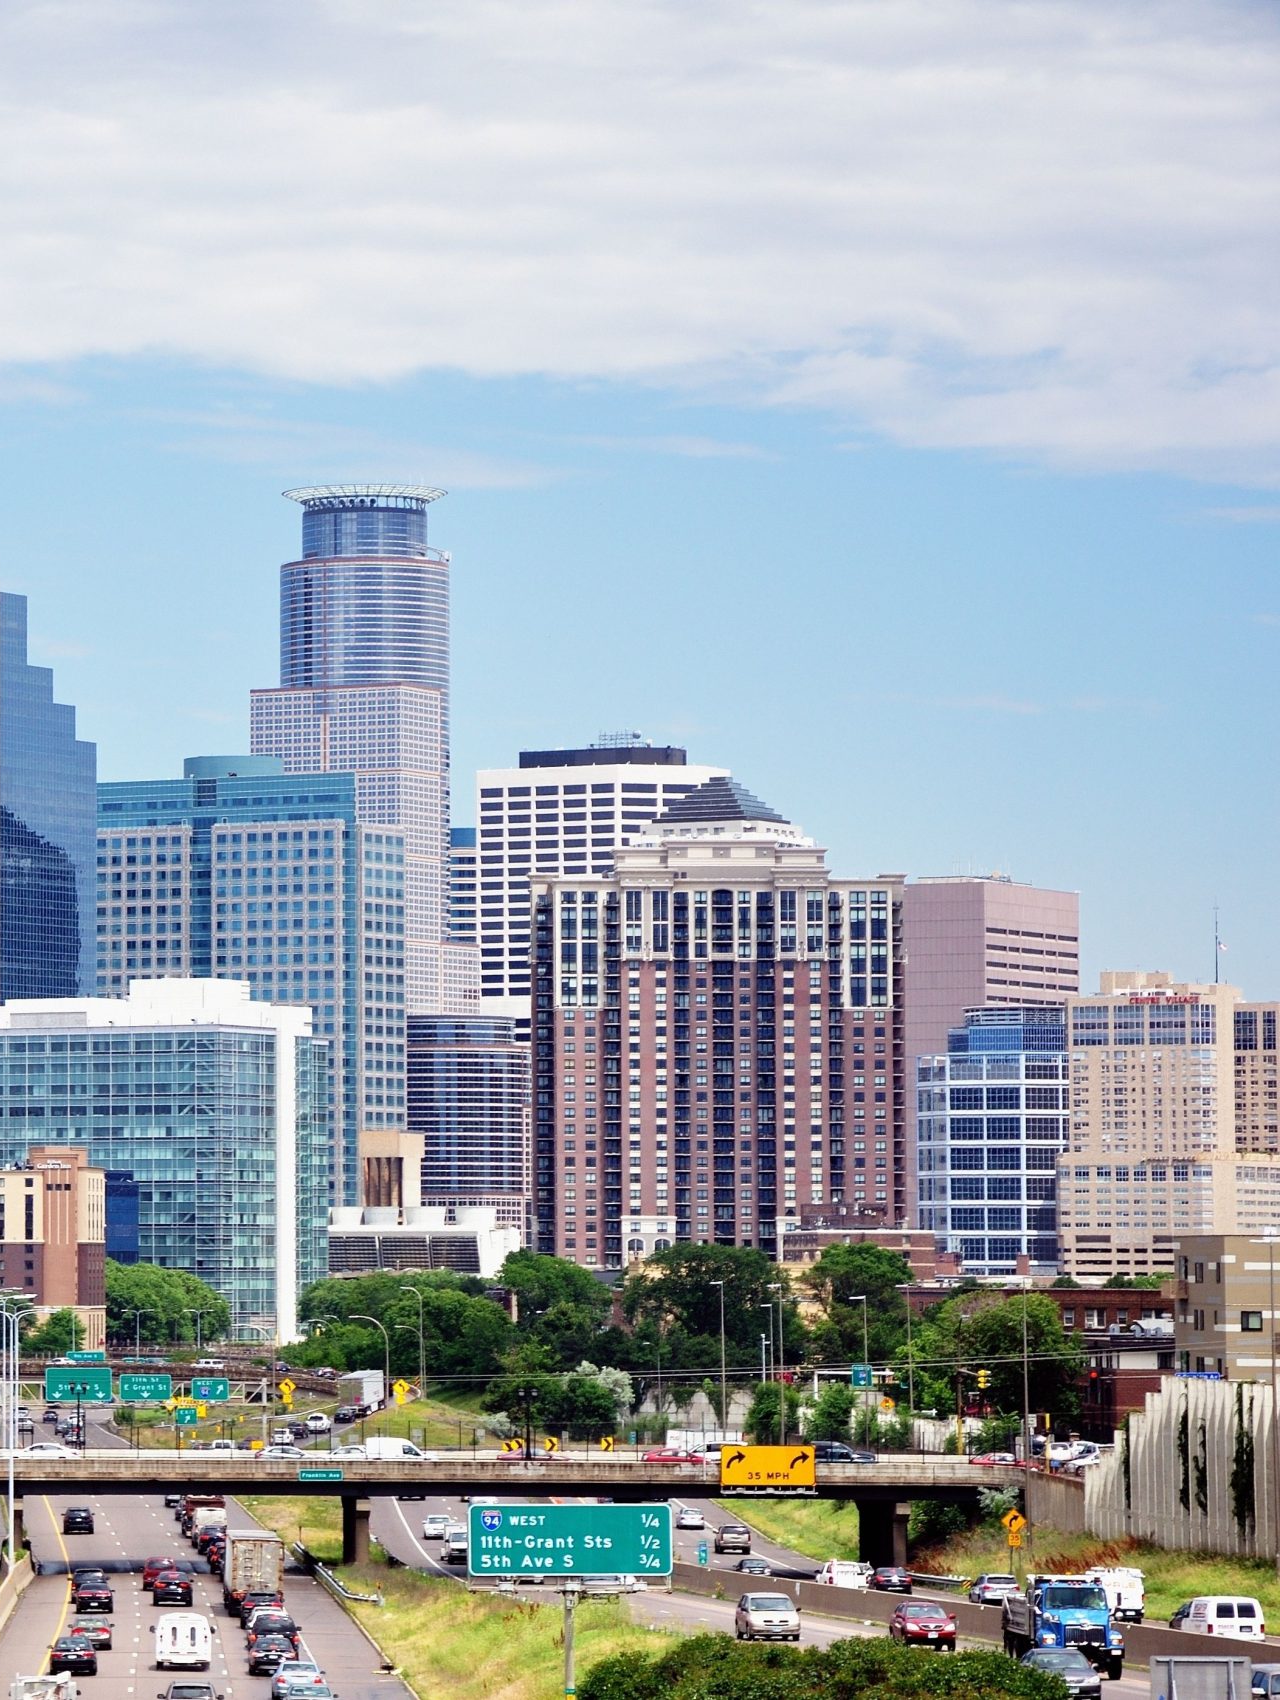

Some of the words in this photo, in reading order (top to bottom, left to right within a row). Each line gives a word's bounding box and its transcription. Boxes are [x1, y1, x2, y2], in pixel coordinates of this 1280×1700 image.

[1166, 996, 1199, 1004] VILLAGE
[748, 1472, 761, 1480] 35
[767, 1472, 790, 1480] MPH
[484, 1517, 499, 1526] 94
[509, 1515, 546, 1526] WEST
[481, 1535, 574, 1549] 11th-Grant
[584, 1535, 613, 1549] Sts
[481, 1554, 511, 1568] 5th
[521, 1554, 554, 1568] Ave
[564, 1554, 574, 1568] S
